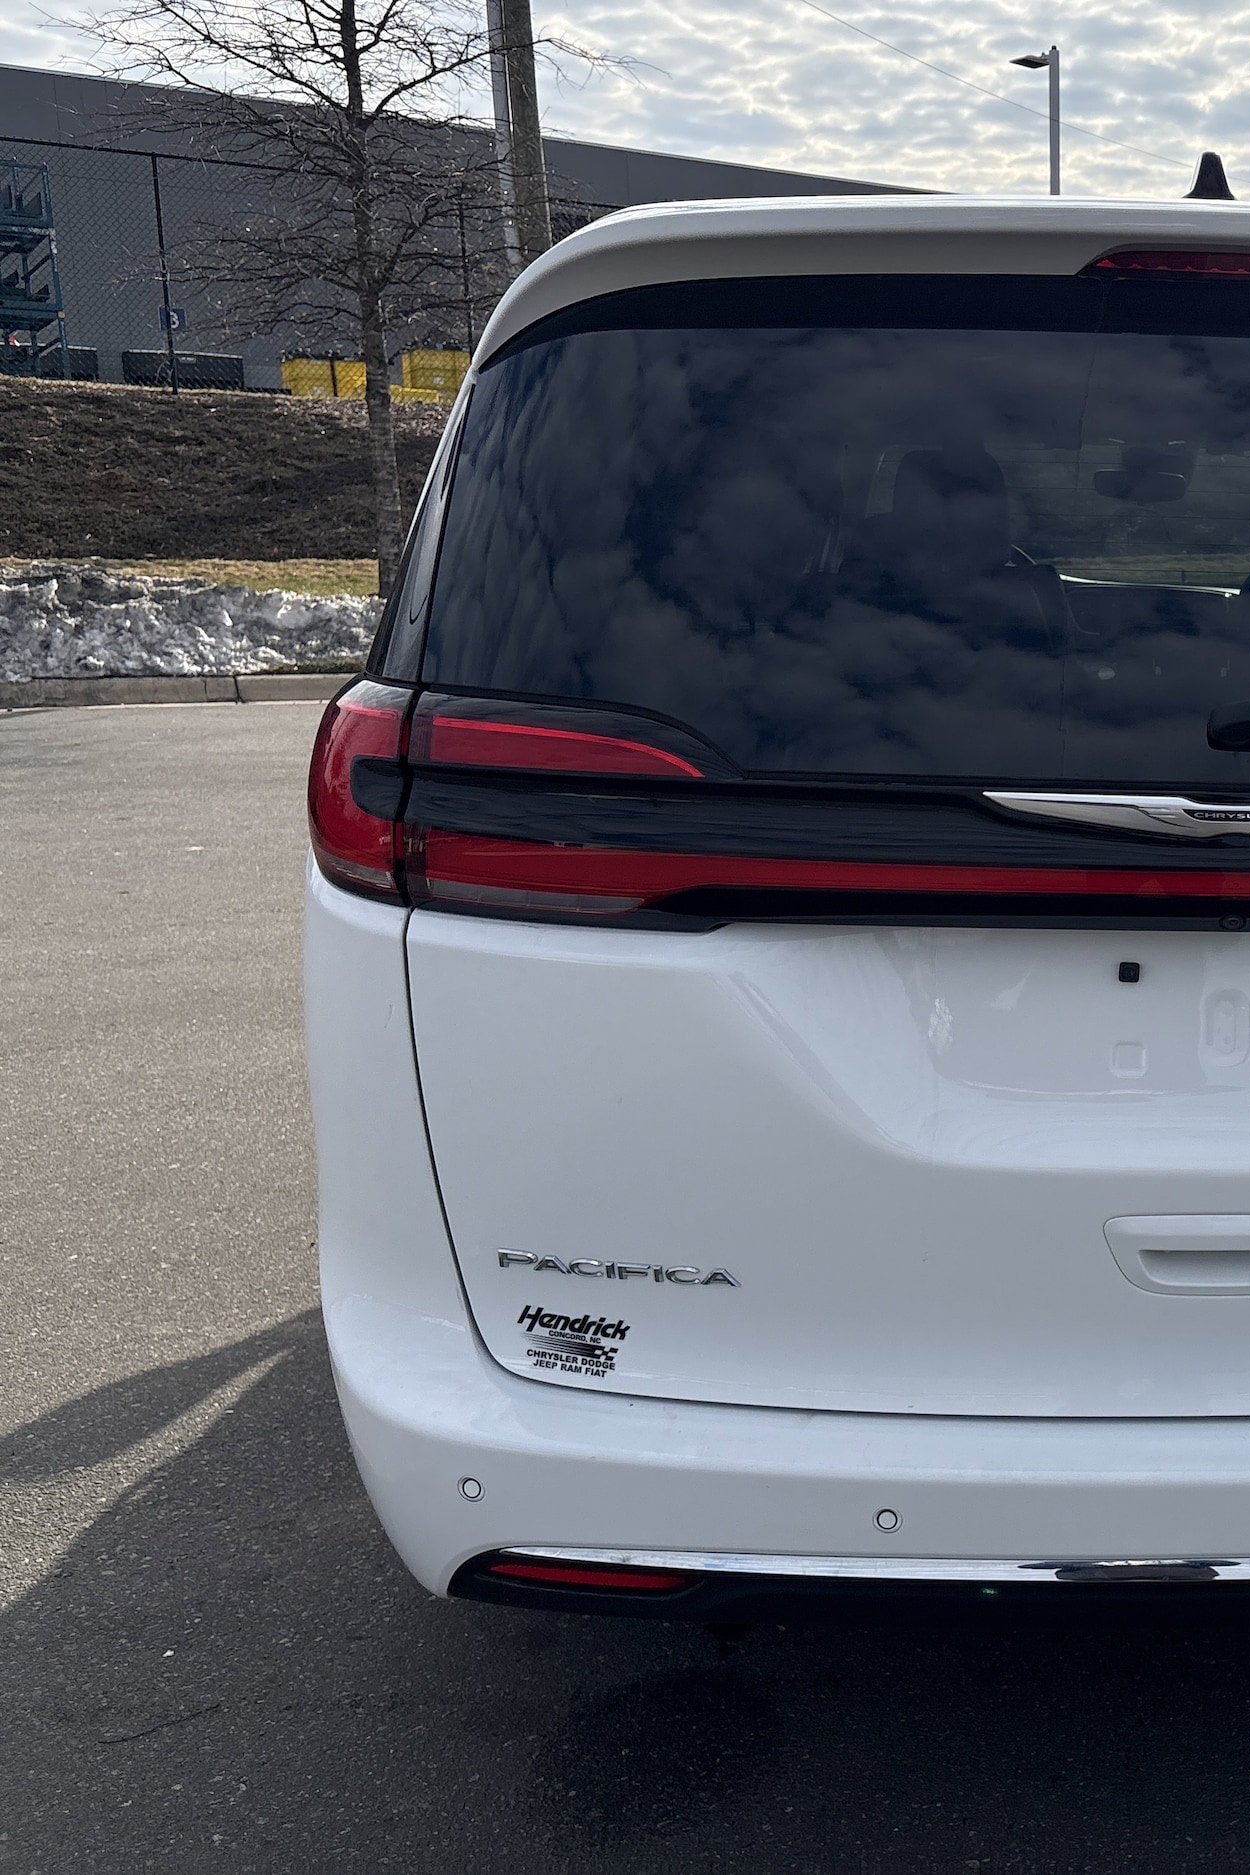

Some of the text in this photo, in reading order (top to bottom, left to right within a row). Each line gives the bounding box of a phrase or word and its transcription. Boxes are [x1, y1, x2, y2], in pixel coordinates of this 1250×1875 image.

[497, 1248, 742, 1288] PACIFICA
[517, 1304, 631, 1340] Hendrick
[548, 1329, 602, 1344] CONCORD, NC
[526, 1348, 616, 1371] CHRYSLER DODGE
[533, 1358, 608, 1378] JEEP RAM FIAT
